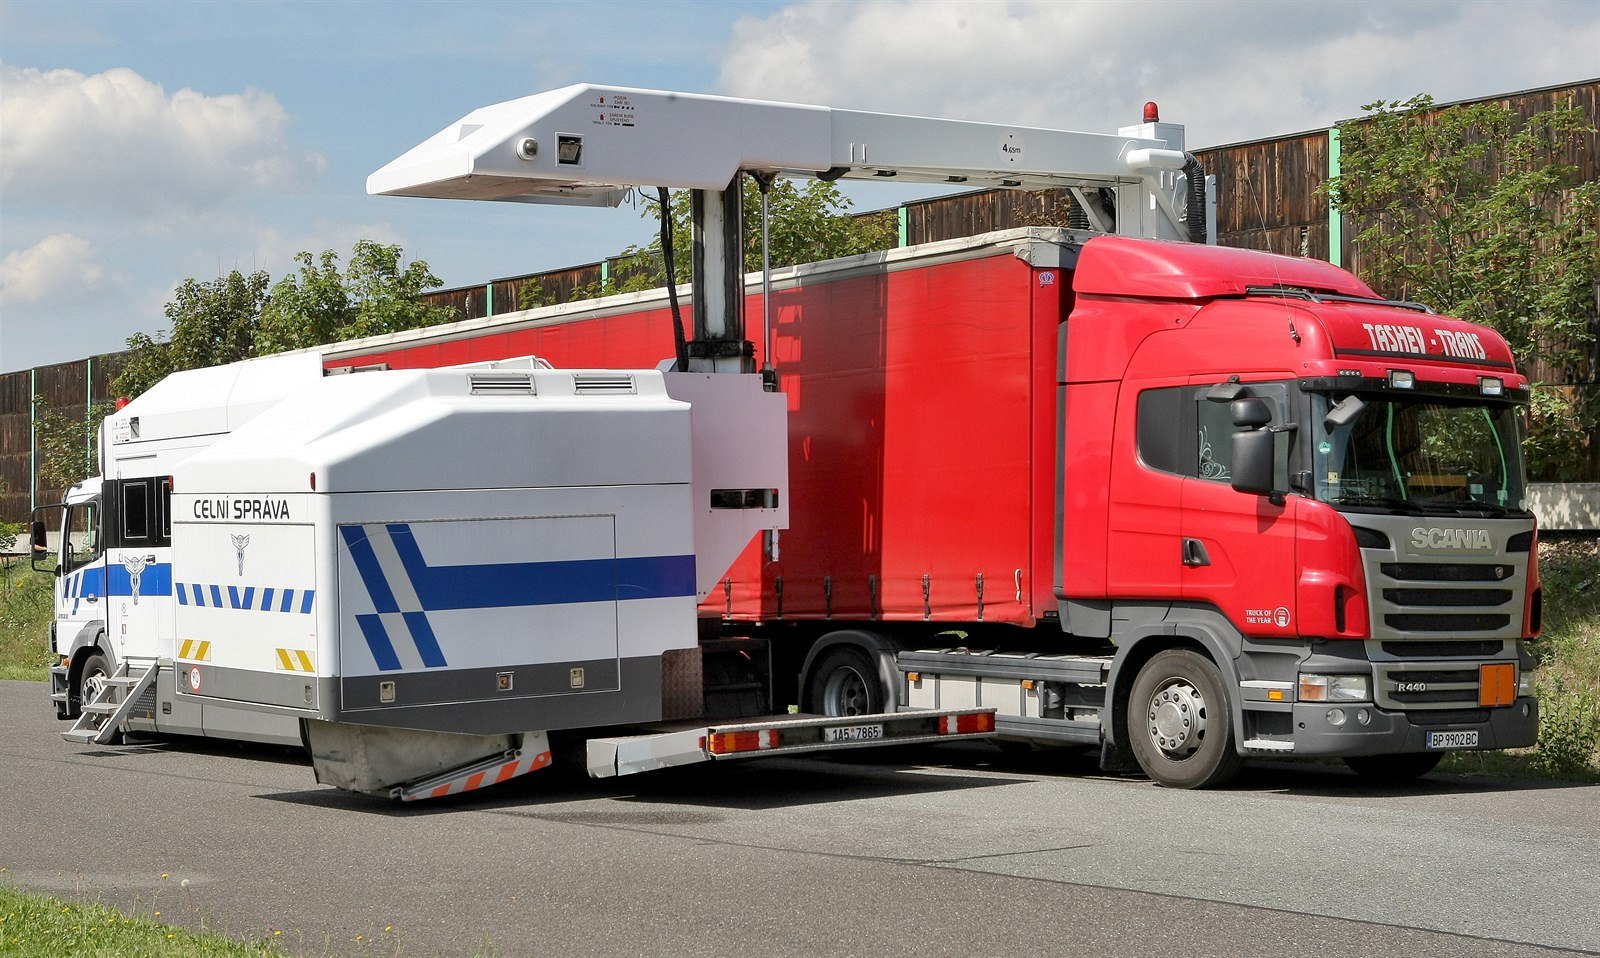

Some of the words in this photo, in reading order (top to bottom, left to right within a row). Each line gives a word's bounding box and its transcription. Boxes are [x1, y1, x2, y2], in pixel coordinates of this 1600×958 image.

[1362, 323, 1426, 355] TASHEV
[1435, 329, 1487, 360] TRANS
[193, 495, 230, 519] CELNÍ
[233, 495, 290, 520] SPRÁVA
[1411, 527, 1492, 550] SCANIA
[833, 728, 850, 741] 1A5
[856, 726, 879, 740] 7865
[1433, 734, 1444, 747] BP
[1445, 733, 1465, 746] 9902
[1466, 733, 1477, 745] BC
